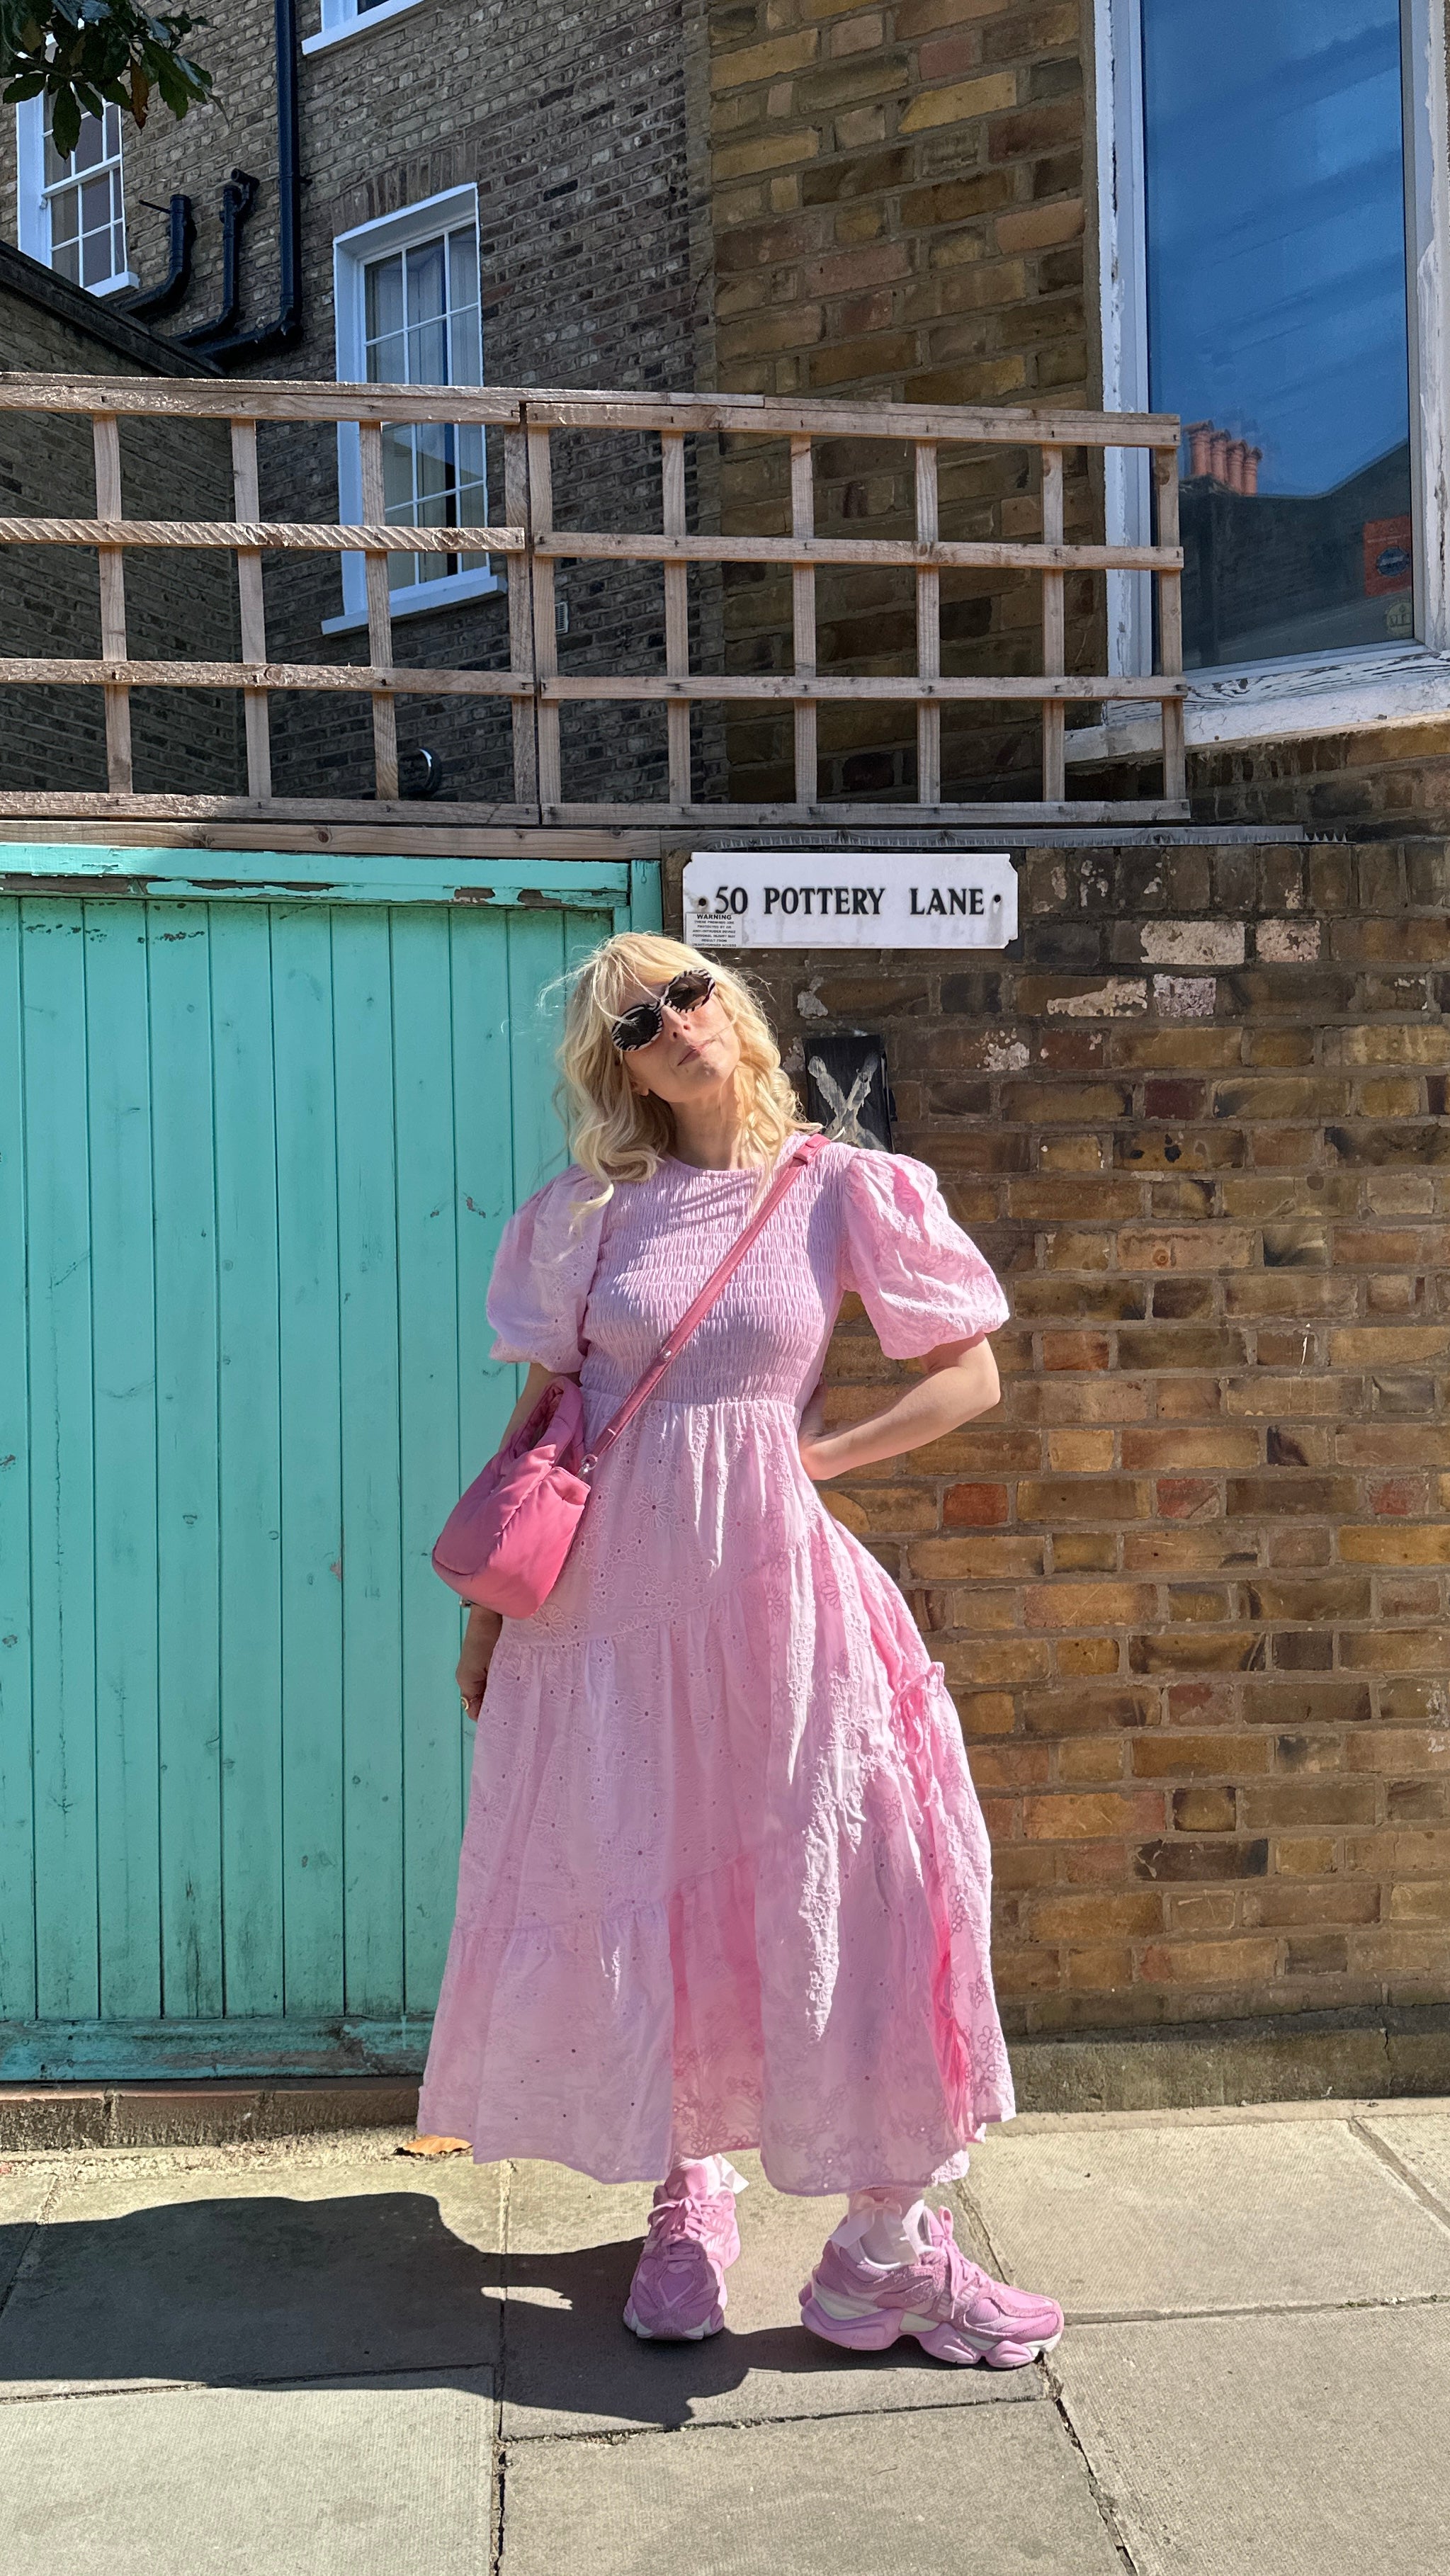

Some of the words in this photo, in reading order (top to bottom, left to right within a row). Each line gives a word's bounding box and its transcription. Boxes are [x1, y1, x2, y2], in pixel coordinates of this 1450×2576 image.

[715, 886, 748, 914] 50
[764, 887, 885, 914] POTTERY
[910, 888, 985, 915] LANE
